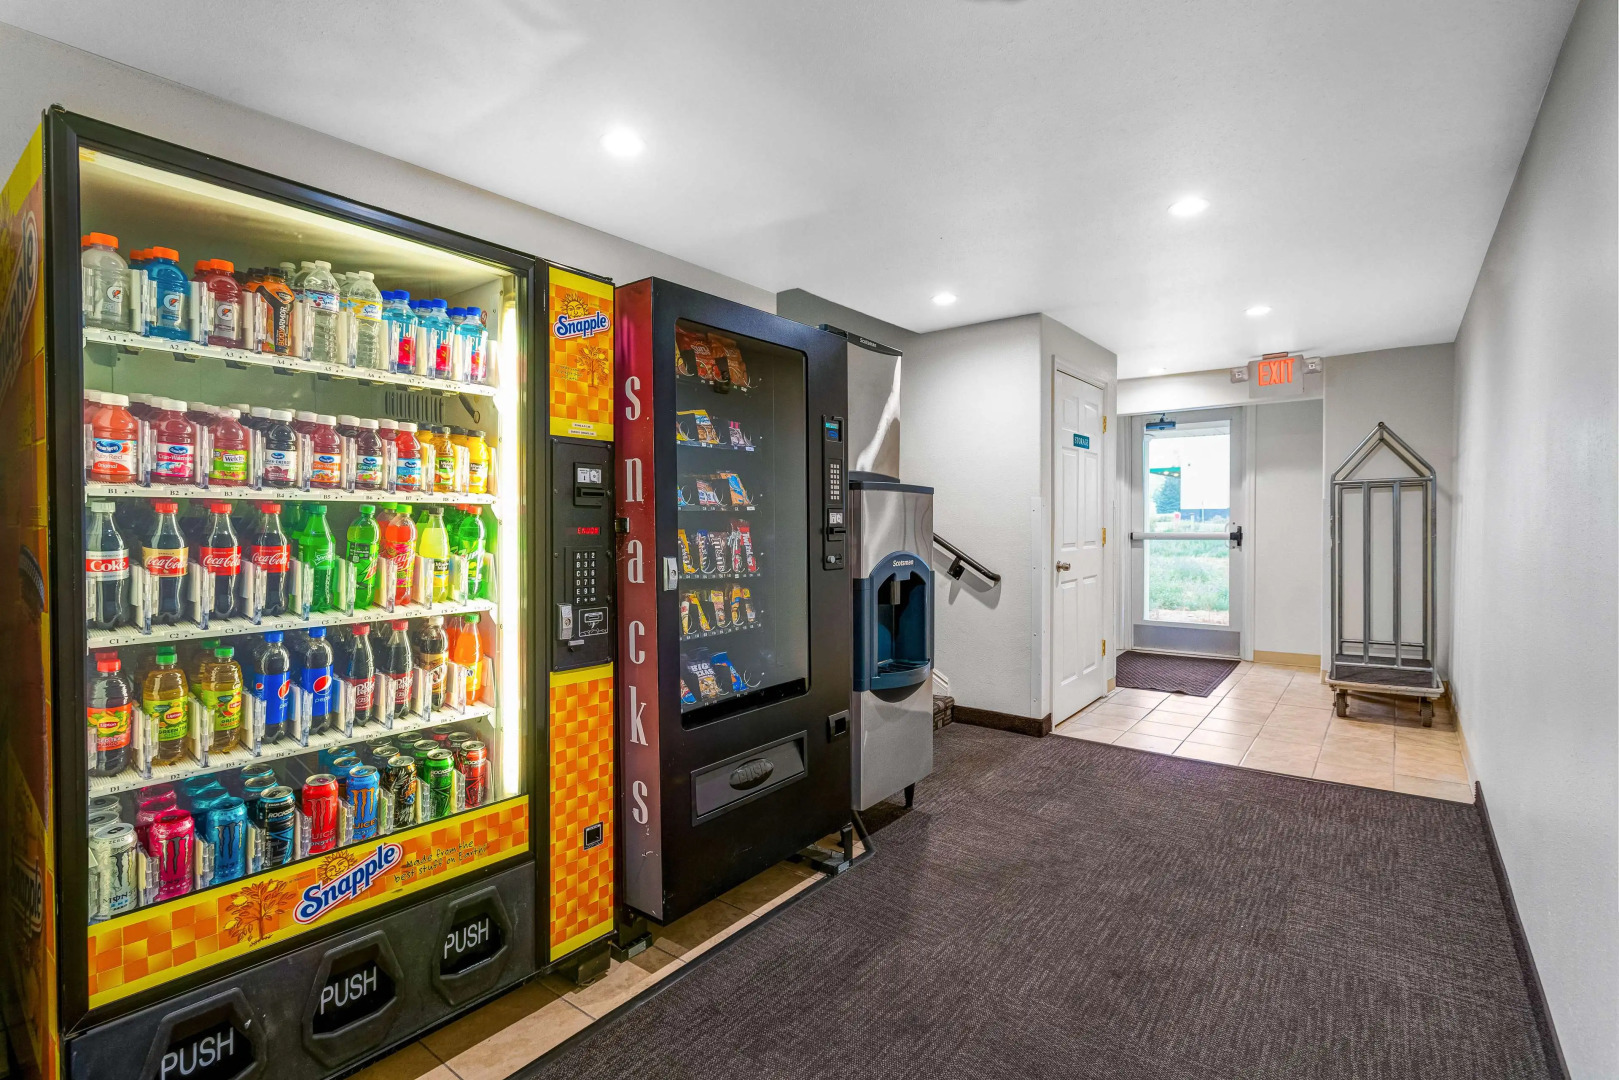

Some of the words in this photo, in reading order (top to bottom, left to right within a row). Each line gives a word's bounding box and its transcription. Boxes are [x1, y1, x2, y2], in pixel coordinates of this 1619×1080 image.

[278, 305, 287, 346] BODYARMOR
[557, 312, 607, 337] Snapple
[1258, 358, 1295, 386] EXIT
[90, 559, 126, 571] Coke
[145, 557, 184, 569] Coca-Cola
[203, 554, 241, 567] Coca-Cola
[252, 552, 289, 565] Coca-Cola
[892, 559, 914, 567] Scotsman
[691, 663, 709, 672] BIG
[311, 830, 335, 840] UICE
[353, 820, 376, 829] UICE
[406, 855, 433, 868] Made
[436, 846, 457, 860] from
[458, 839, 474, 851] the
[300, 845, 396, 918] Snapple
[394, 868, 416, 883] best
[418, 858, 443, 875] stuff
[446, 856, 457, 865] on
[444, 917, 489, 959] PUSH
[320, 966, 377, 1015] PUSH
[160, 1027, 235, 1080] PUSH
